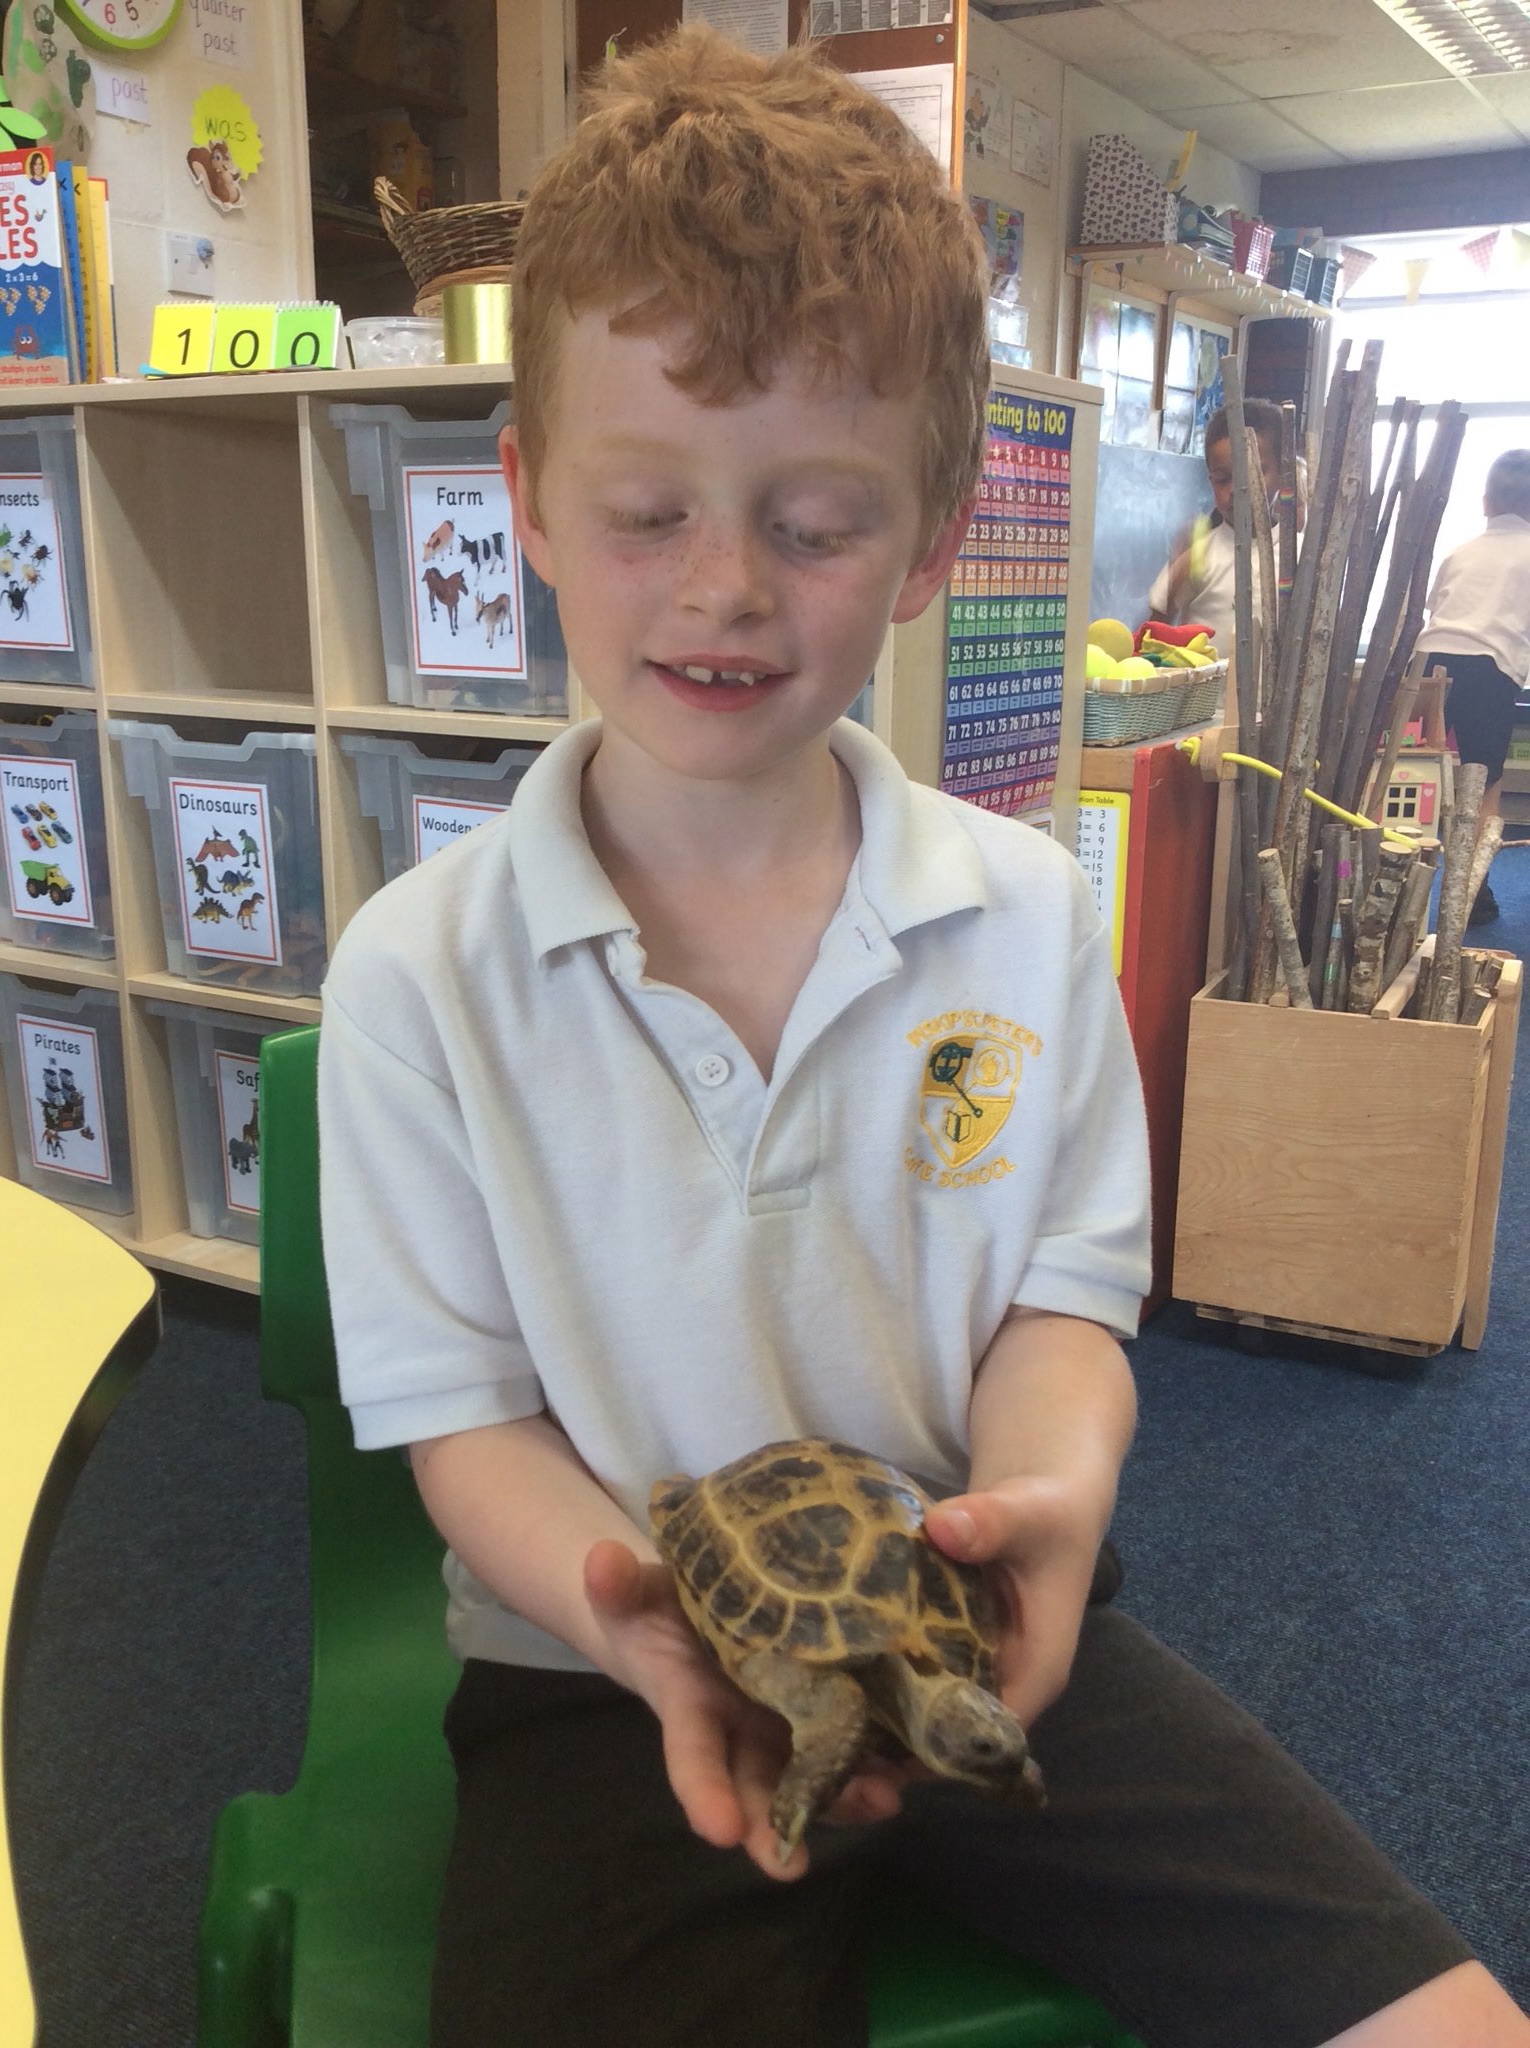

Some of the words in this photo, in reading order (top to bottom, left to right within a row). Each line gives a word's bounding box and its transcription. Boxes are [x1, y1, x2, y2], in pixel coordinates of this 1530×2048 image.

[105, 3, 116, 24] 6
[125, 0, 139, 21] 5
[188, 0, 247, 28] quarter
[203, 32, 236, 56] past
[112, 78, 147, 108] past
[205, 116, 247, 143] was
[0, 194, 29, 226] ES
[987, 397, 1024, 434] nting
[1027, 404, 1040, 432] to
[1044, 408, 1066, 436] 100
[1005, 446, 1011, 460] 5
[1018, 448, 1023, 463] 6
[1030, 450, 1034, 464] 7
[1040, 451, 1046, 466] 8
[1052, 453, 1057, 467] 9
[1061, 454, 1069, 468] 10
[0, 491, 40, 506] nsects
[437, 487, 484, 506] Farm
[980, 483, 988, 499] 13
[993, 485, 1001, 500] 14
[1006, 486, 1012, 500] 15
[1018, 488, 1025, 501] 16
[1029, 488, 1036, 503] 17
[1040, 490, 1047, 504] 18
[1051, 491, 1058, 505] 19
[1061, 492, 1069, 506] 20
[980, 524, 989, 539] 23
[992, 525, 1002, 540] 24
[1005, 526, 1014, 540] 25
[1016, 526, 1025, 541] 26
[1028, 527, 1037, 542] 27
[1040, 528, 1047, 542] 28
[1050, 529, 1058, 542] 29
[1060, 529, 1068, 543] 30
[952, 605, 961, 620] 41
[965, 605, 975, 620] 42
[978, 605, 988, 619] 43
[990, 605, 1000, 619] 44
[1002, 604, 1012, 618] 45
[1014, 604, 1023, 618] 46
[1025, 603, 1033, 618] 47
[1035, 603, 1044, 617] 48
[1046, 603, 1055, 617] 49
[1057, 603, 1065, 616] 50
[951, 646, 959, 661] 51
[963, 645, 973, 660] 52
[976, 644, 986, 659] 53
[989, 643, 998, 658] 54
[1001, 643, 1010, 657] 55
[1013, 641, 1021, 656] 56
[1024, 641, 1031, 655] 57
[1034, 640, 1042, 654] 58
[1044, 639, 1053, 653] 59
[1055, 639, 1064, 652] 60
[949, 686, 958, 701] 61
[961, 684, 972, 699] 62
[974, 683, 984, 698] 63
[987, 682, 997, 696] 64
[999, 680, 1009, 695] 65
[1011, 679, 1020, 693] 66
[1022, 678, 1030, 692] 67
[1033, 677, 1041, 691] 68
[1043, 676, 1052, 689] 69
[1054, 675, 1062, 688] 70
[948, 725, 956, 740] 71
[960, 723, 970, 738] 72
[973, 721, 982, 736] 73
[986, 720, 995, 735] 74
[998, 718, 1007, 732] 75
[1009, 716, 1018, 731] 76
[1021, 714, 1029, 729] 77
[1032, 713, 1040, 727] 78
[1042, 711, 1051, 725] 79
[1052, 710, 1060, 723] 80
[944, 764, 953, 779] 81
[957, 762, 968, 777] 82
[970, 760, 980, 774] 83
[983, 757, 992, 772] 84
[995, 755, 1004, 769] 85
[1006, 753, 1016, 767] 86
[1019, 751, 1028, 765] 87
[1029, 749, 1038, 763] 88
[1040, 747, 1048, 760] 89
[1049, 745, 1059, 758] 90
[3, 771, 69, 794] Transport
[179, 793, 258, 816] Dinosaurs
[422, 816, 472, 834] Wooden
[34, 1033, 81, 1055] Pirates
[237, 1070, 260, 1092] Saf
